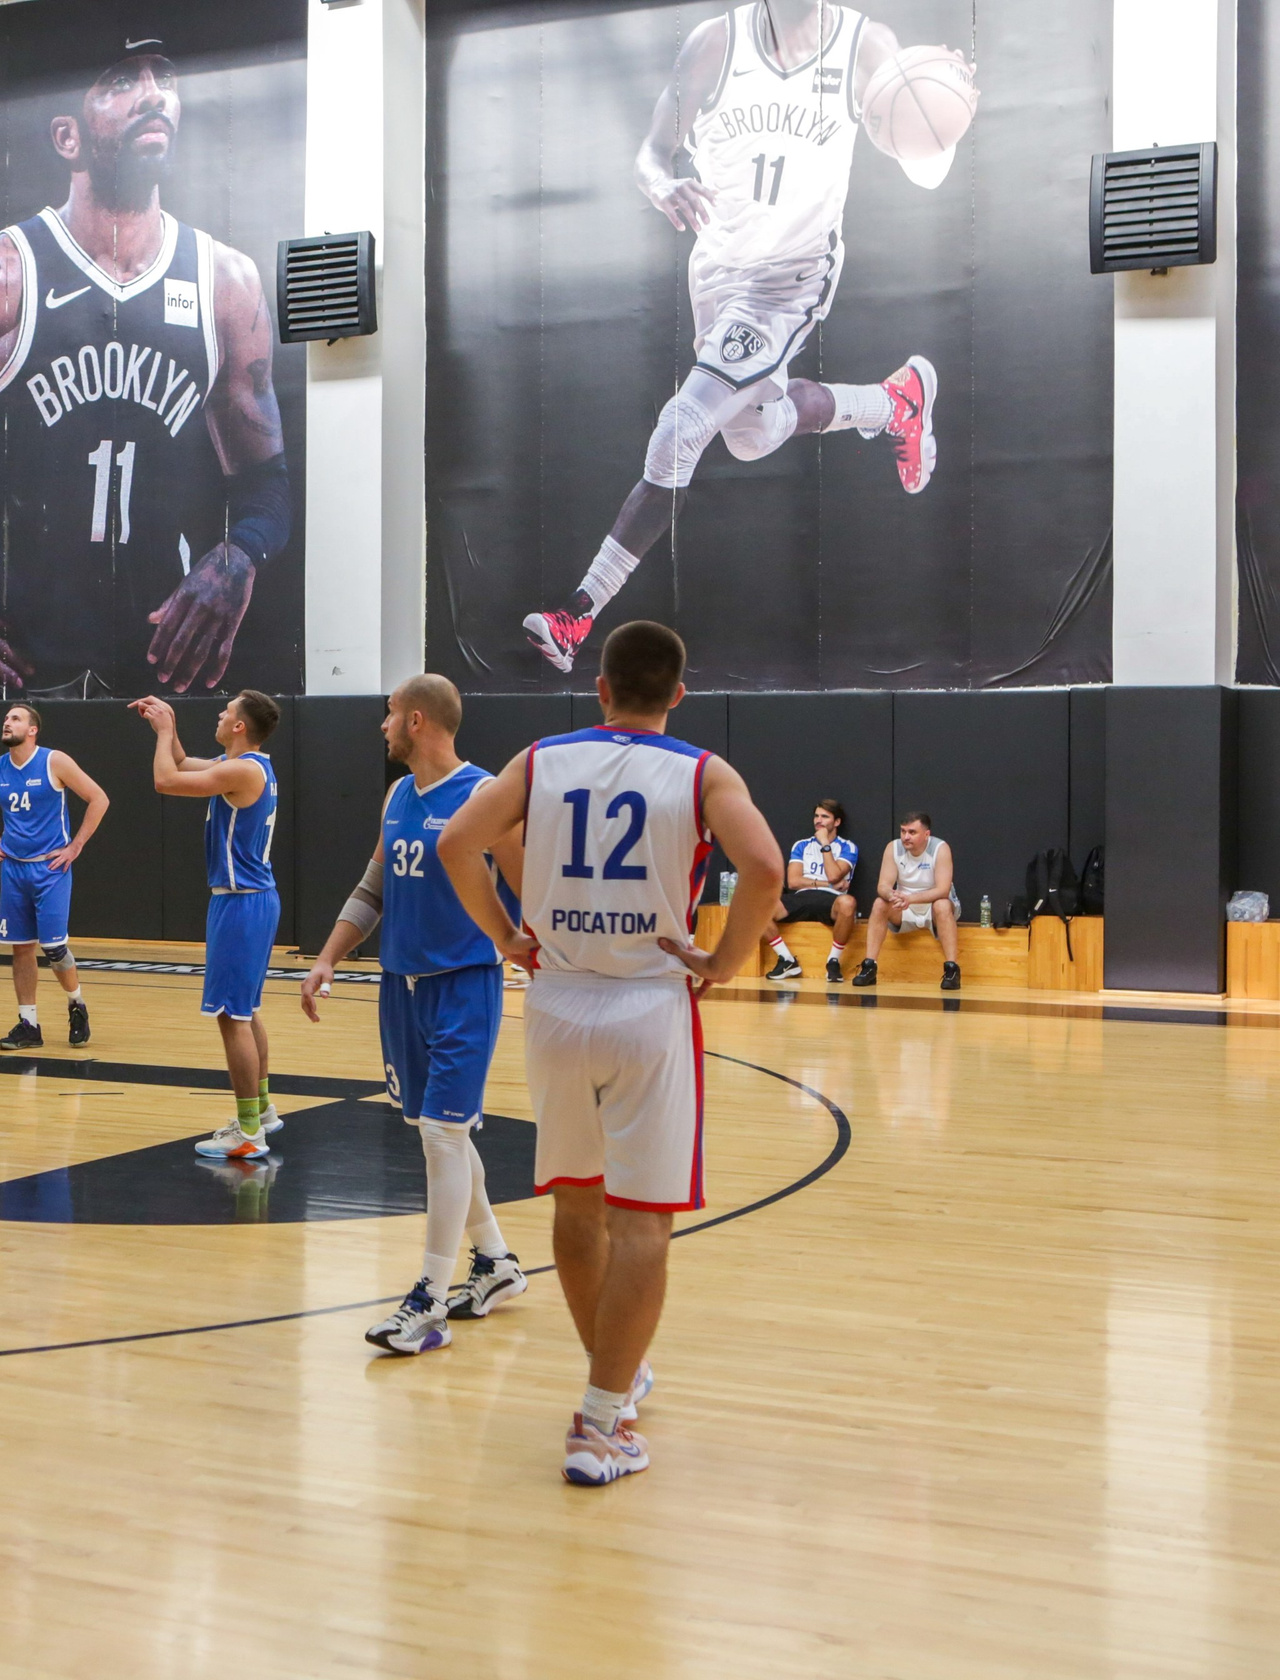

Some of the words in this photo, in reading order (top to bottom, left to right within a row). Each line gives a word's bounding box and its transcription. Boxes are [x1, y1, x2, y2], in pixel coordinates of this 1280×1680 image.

[719, 101, 842, 147] BROOKLYN
[751, 152, 786, 206] 11
[166, 293, 195, 310] infor
[726, 325, 762, 354] NETS
[26, 341, 200, 437] BROOKLYN
[88, 439, 135, 544] 11
[9, 791, 31, 812] 24
[562, 788, 647, 880] 12
[392, 838, 425, 878] 32
[810, 861, 825, 875] 91
[552, 909, 657, 935] РОСАТОМ
[385, 1063, 400, 1097] 3
